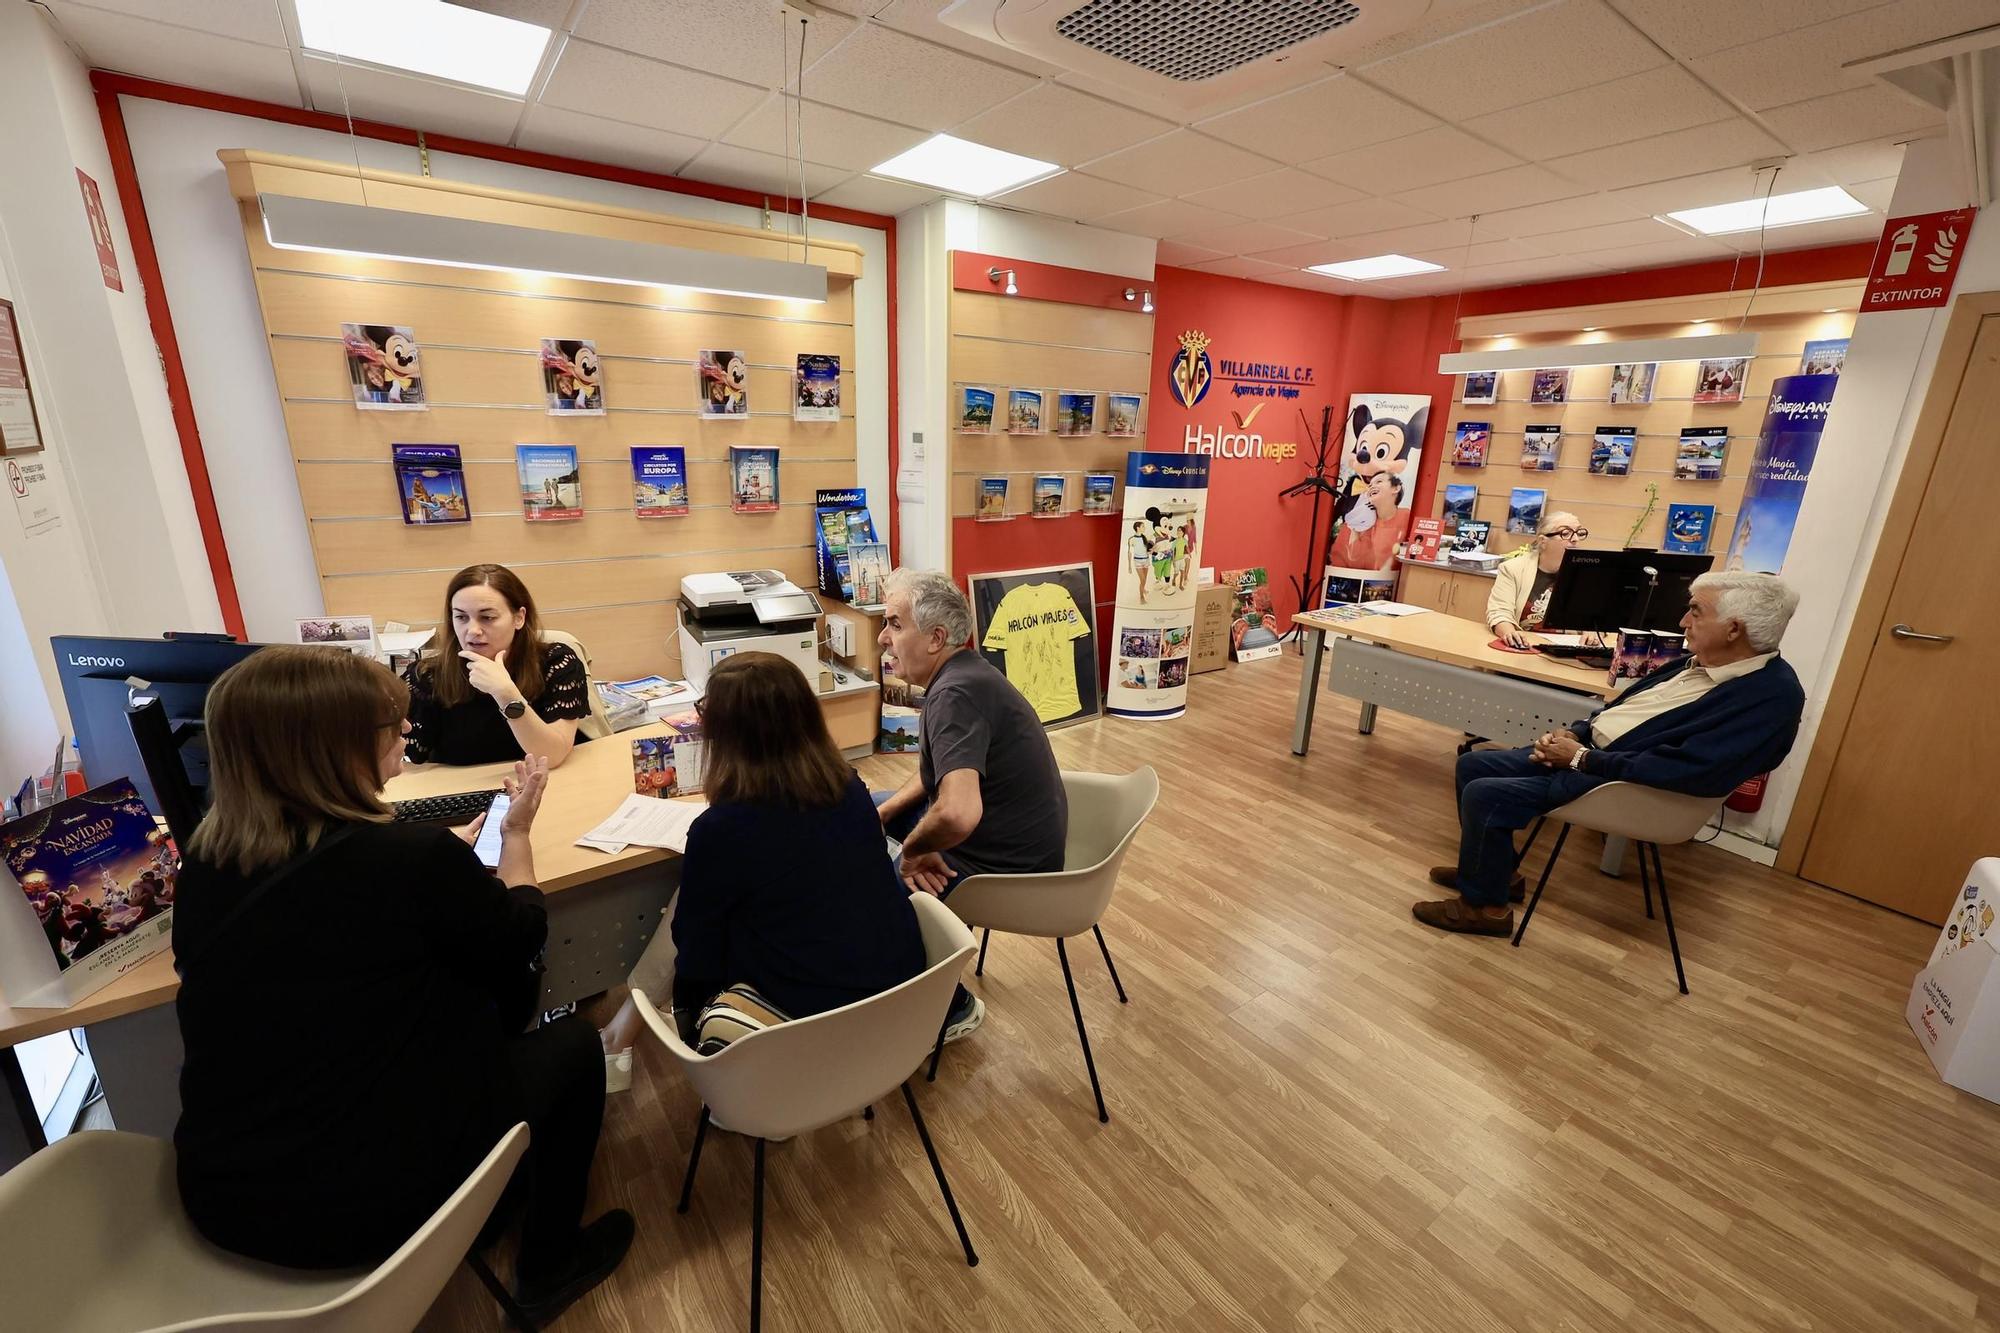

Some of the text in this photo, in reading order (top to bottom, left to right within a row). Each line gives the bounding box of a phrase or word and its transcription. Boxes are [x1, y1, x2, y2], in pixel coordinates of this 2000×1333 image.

[1870, 287, 1942, 303] EXTINTOR
[1220, 360, 1314, 382] VILLARREAL C.F.
[1231, 382, 1300, 400] Agencia de Viajes
[1262, 442, 1297, 464] viajes
[1767, 457, 1796, 471] Magia
[818, 492, 862, 503] Wonderbox
[1572, 556, 1600, 564] Lenovo
[1040, 608, 1068, 626] VIAJES
[68, 653, 125, 667] Lenovo
[45, 818, 114, 852] NAVIDAD
[63, 830, 113, 856] ENCANTADA
[1936, 986, 1952, 1010] MAGIA
